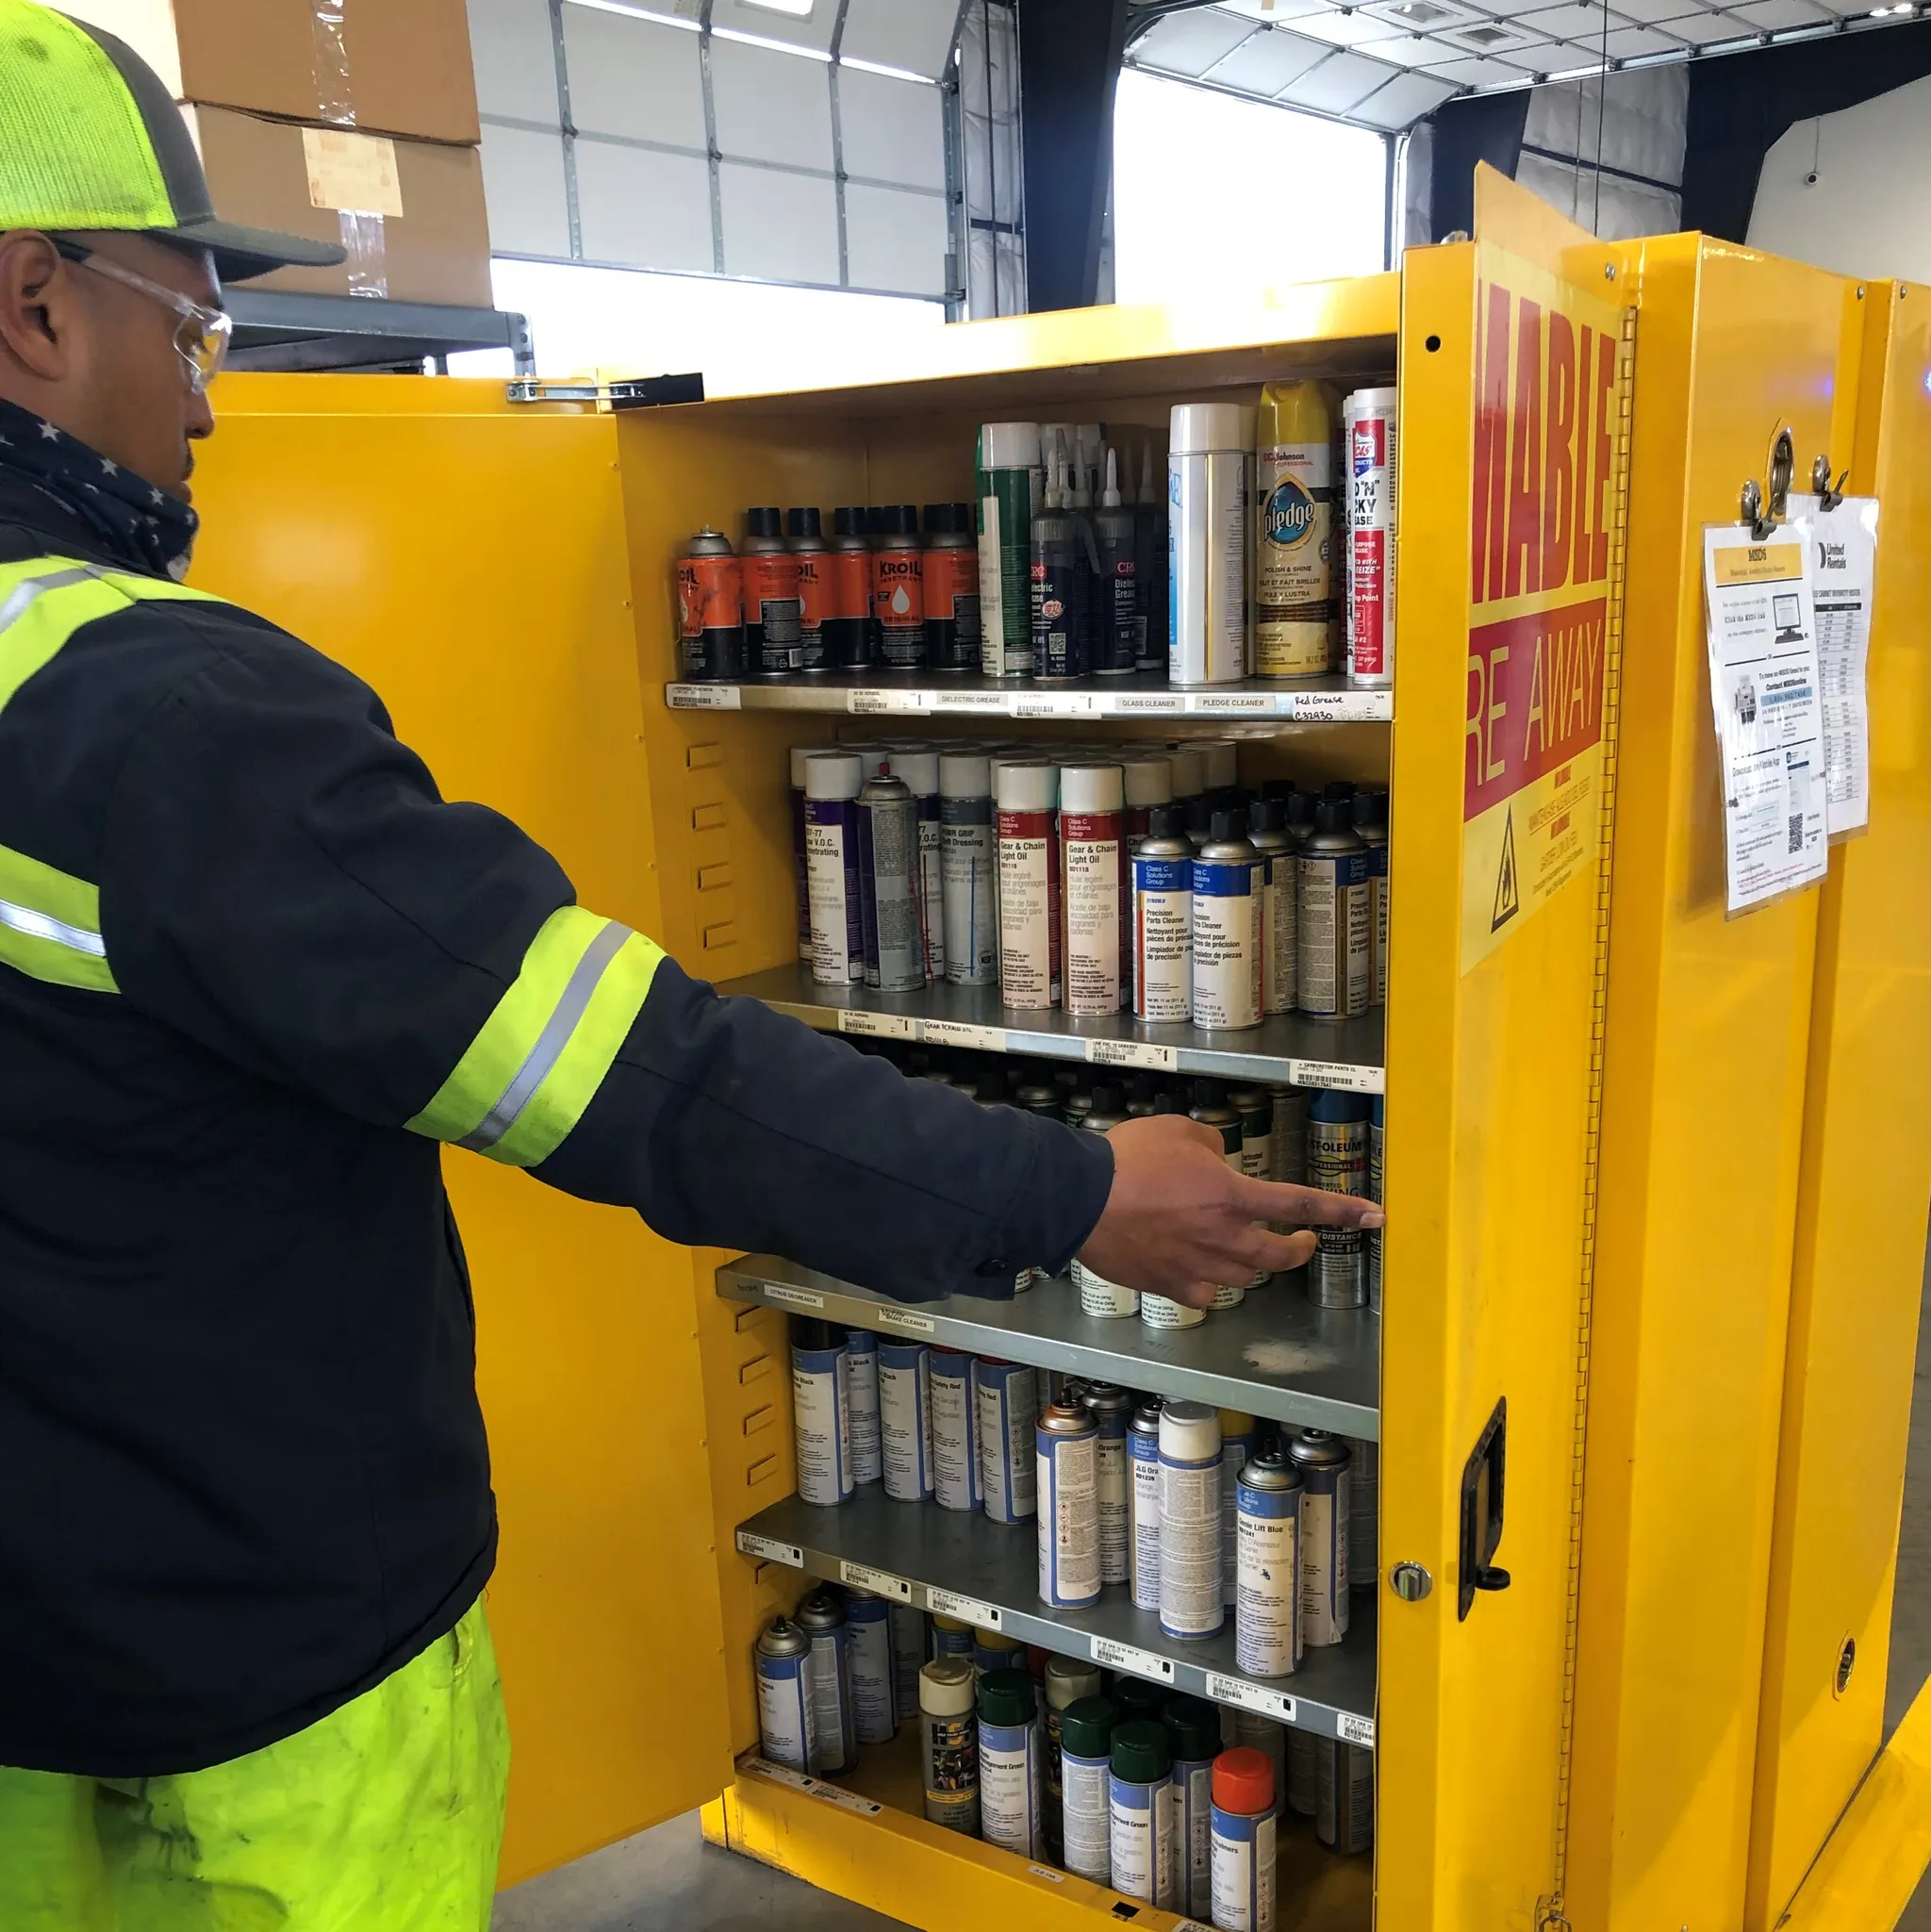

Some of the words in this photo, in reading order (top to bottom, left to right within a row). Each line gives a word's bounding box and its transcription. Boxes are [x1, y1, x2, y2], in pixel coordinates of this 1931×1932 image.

[1264, 501, 1314, 541] pledge
[1826, 543, 1845, 556] United
[1826, 557, 1846, 570] Rentals
[880, 560, 923, 577] KROIL
[1524, 619, 1602, 762] AWAY
[1145, 700, 1176, 708] CLEANER
[1295, 696, 1310, 705] Red
[1312, 695, 1344, 705] Grease
[958, 829, 975, 838] GRIP
[952, 838, 983, 849] Dressing
[1000, 841, 1014, 850] Gear
[1015, 841, 1021, 850] &
[1023, 841, 1046, 850] Chain
[1069, 845, 1085, 854] Gear
[1086, 845, 1093, 854] &
[1095, 845, 1117, 853] Chain
[1000, 852, 1015, 862] Light
[1016, 852, 1028, 861] Oil
[1069, 855, 1088, 865] Light
[1089, 855, 1100, 864] Oil
[1146, 928, 1175, 936] Nettoyant
[1175, 927, 1188, 935] pour
[1146, 934, 1165, 943] pièces
[1213, 941, 1241, 949] précision
[1146, 946, 1175, 954] Limpiador
[1154, 953, 1182, 962] precisión
[1223, 951, 1243, 960] piezas
[1304, 1062, 1333, 1070] CARBURETOR
[769, 1288, 787, 1298] CITRUS
[902, 1318, 928, 1329] CLEANER
[1136, 1464, 1147, 1473] JLG
[1254, 1523, 1266, 1532] Lift
[1008, 1761, 1025, 1770] Green
[1130, 1821, 1148, 1829] Green
